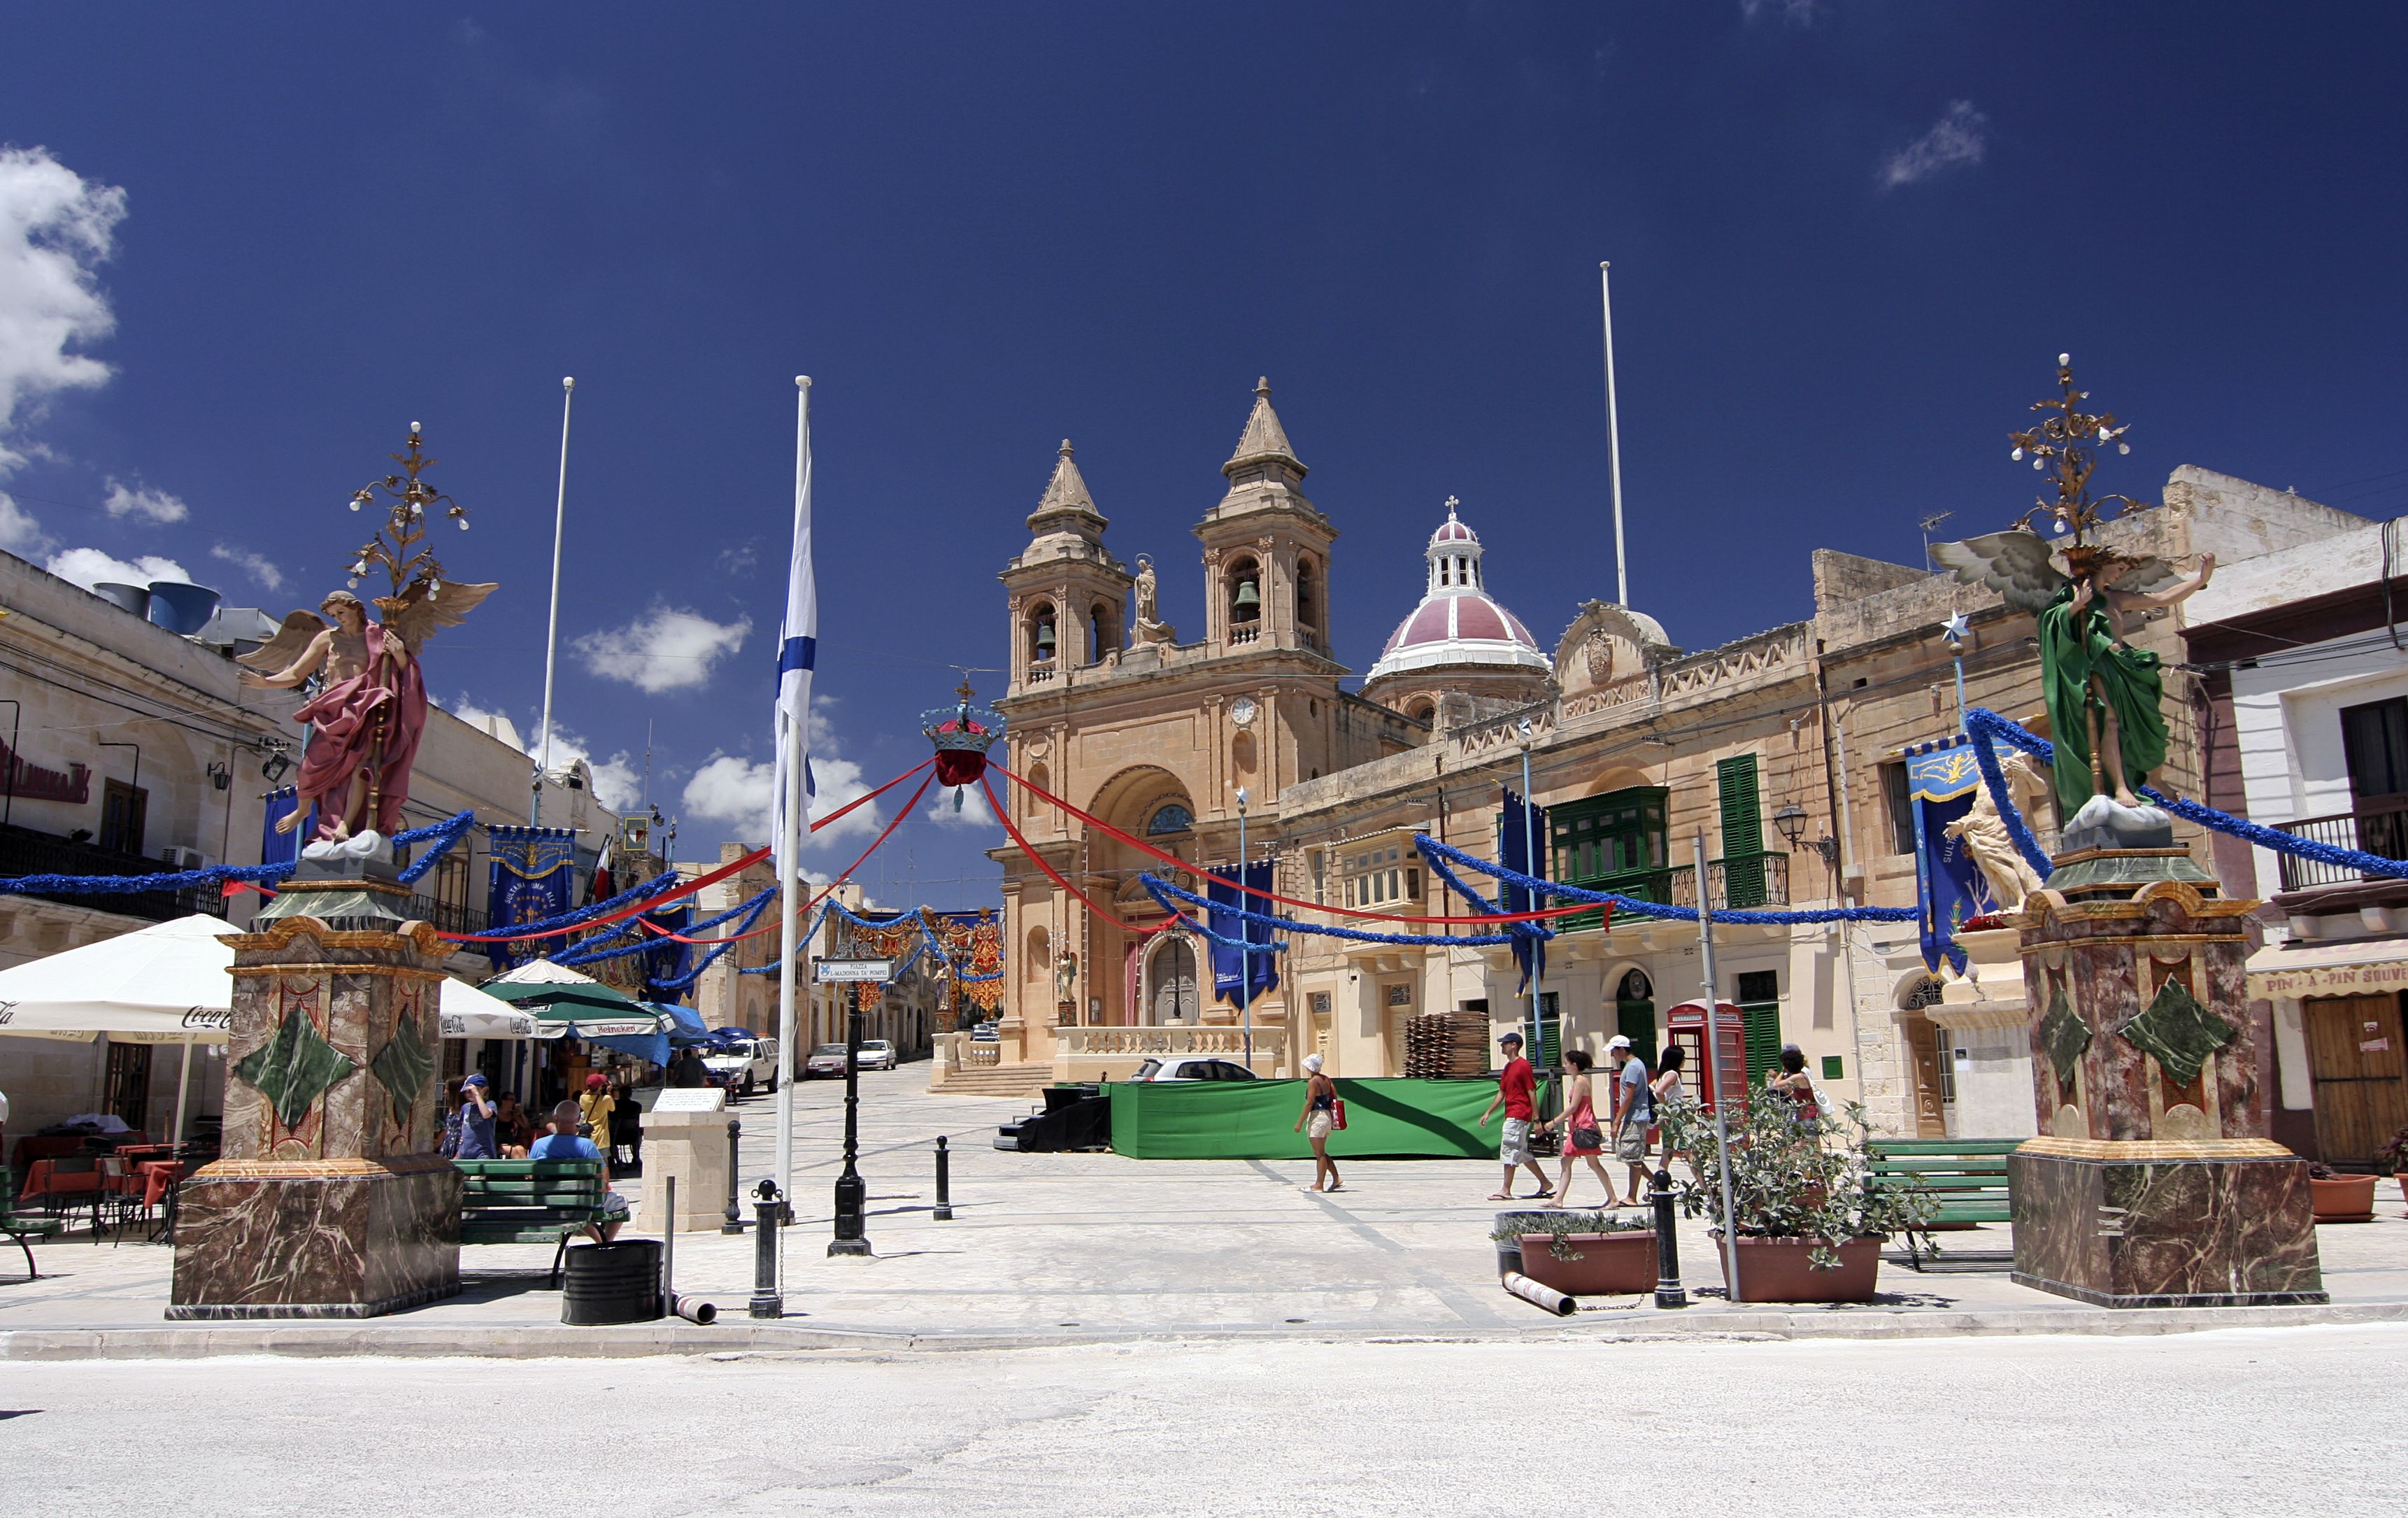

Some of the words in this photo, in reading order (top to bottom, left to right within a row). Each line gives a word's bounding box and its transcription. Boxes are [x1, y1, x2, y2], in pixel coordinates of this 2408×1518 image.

[546, 891, 556, 907] ALLA
[2266, 978, 2293, 992] PIN
[182, 1005, 231, 1029] Coca-C
[597, 1025, 636, 1034] Heineken
